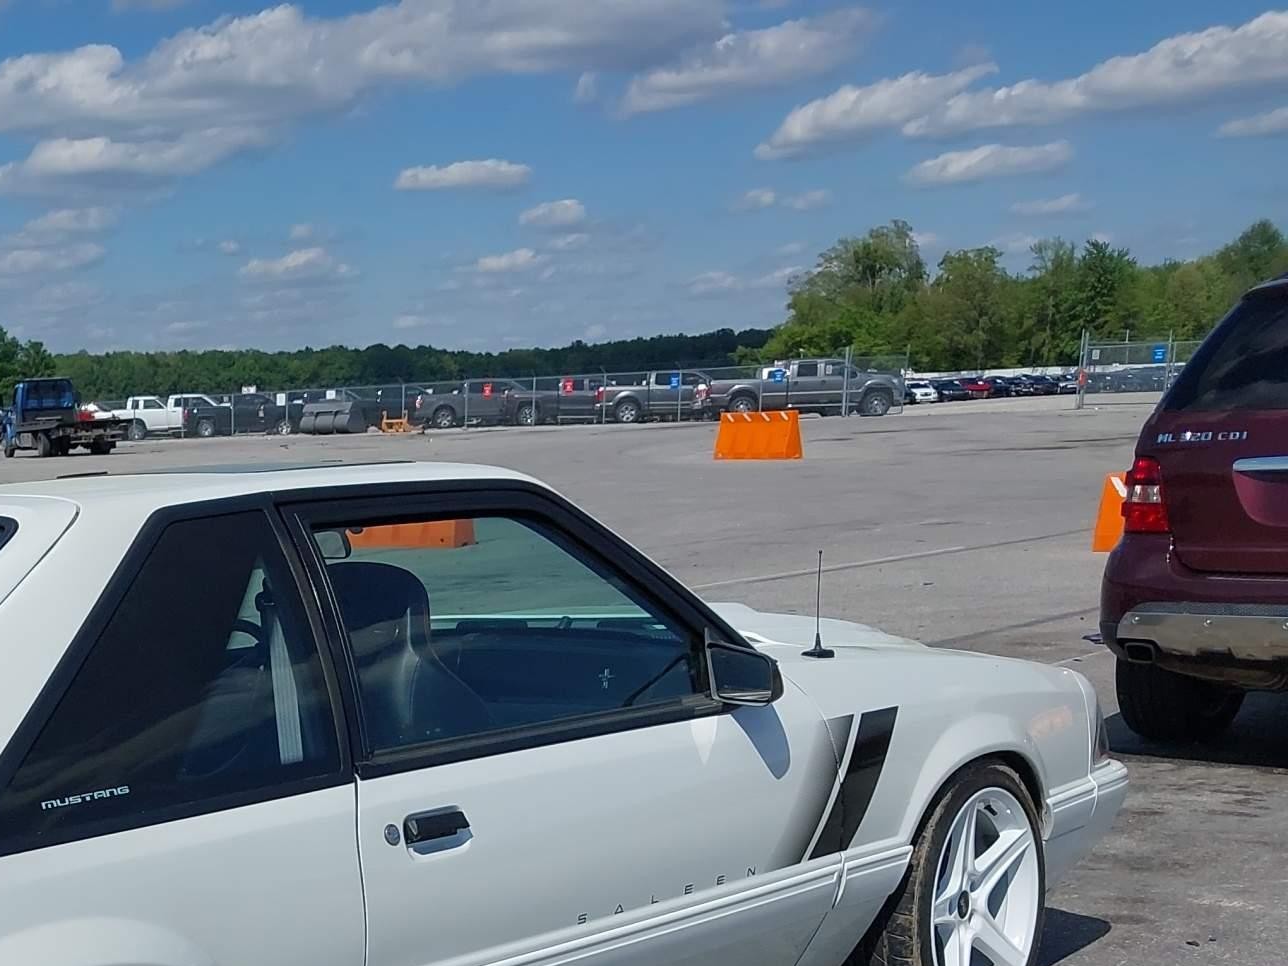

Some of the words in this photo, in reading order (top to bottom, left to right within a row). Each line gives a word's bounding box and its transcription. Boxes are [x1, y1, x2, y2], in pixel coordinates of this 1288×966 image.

[1156, 432, 1177, 443] ML
[1217, 431, 1248, 441] CDI
[41, 785, 130, 810] MUSTANG
[577, 866, 757, 925] SALEEN
